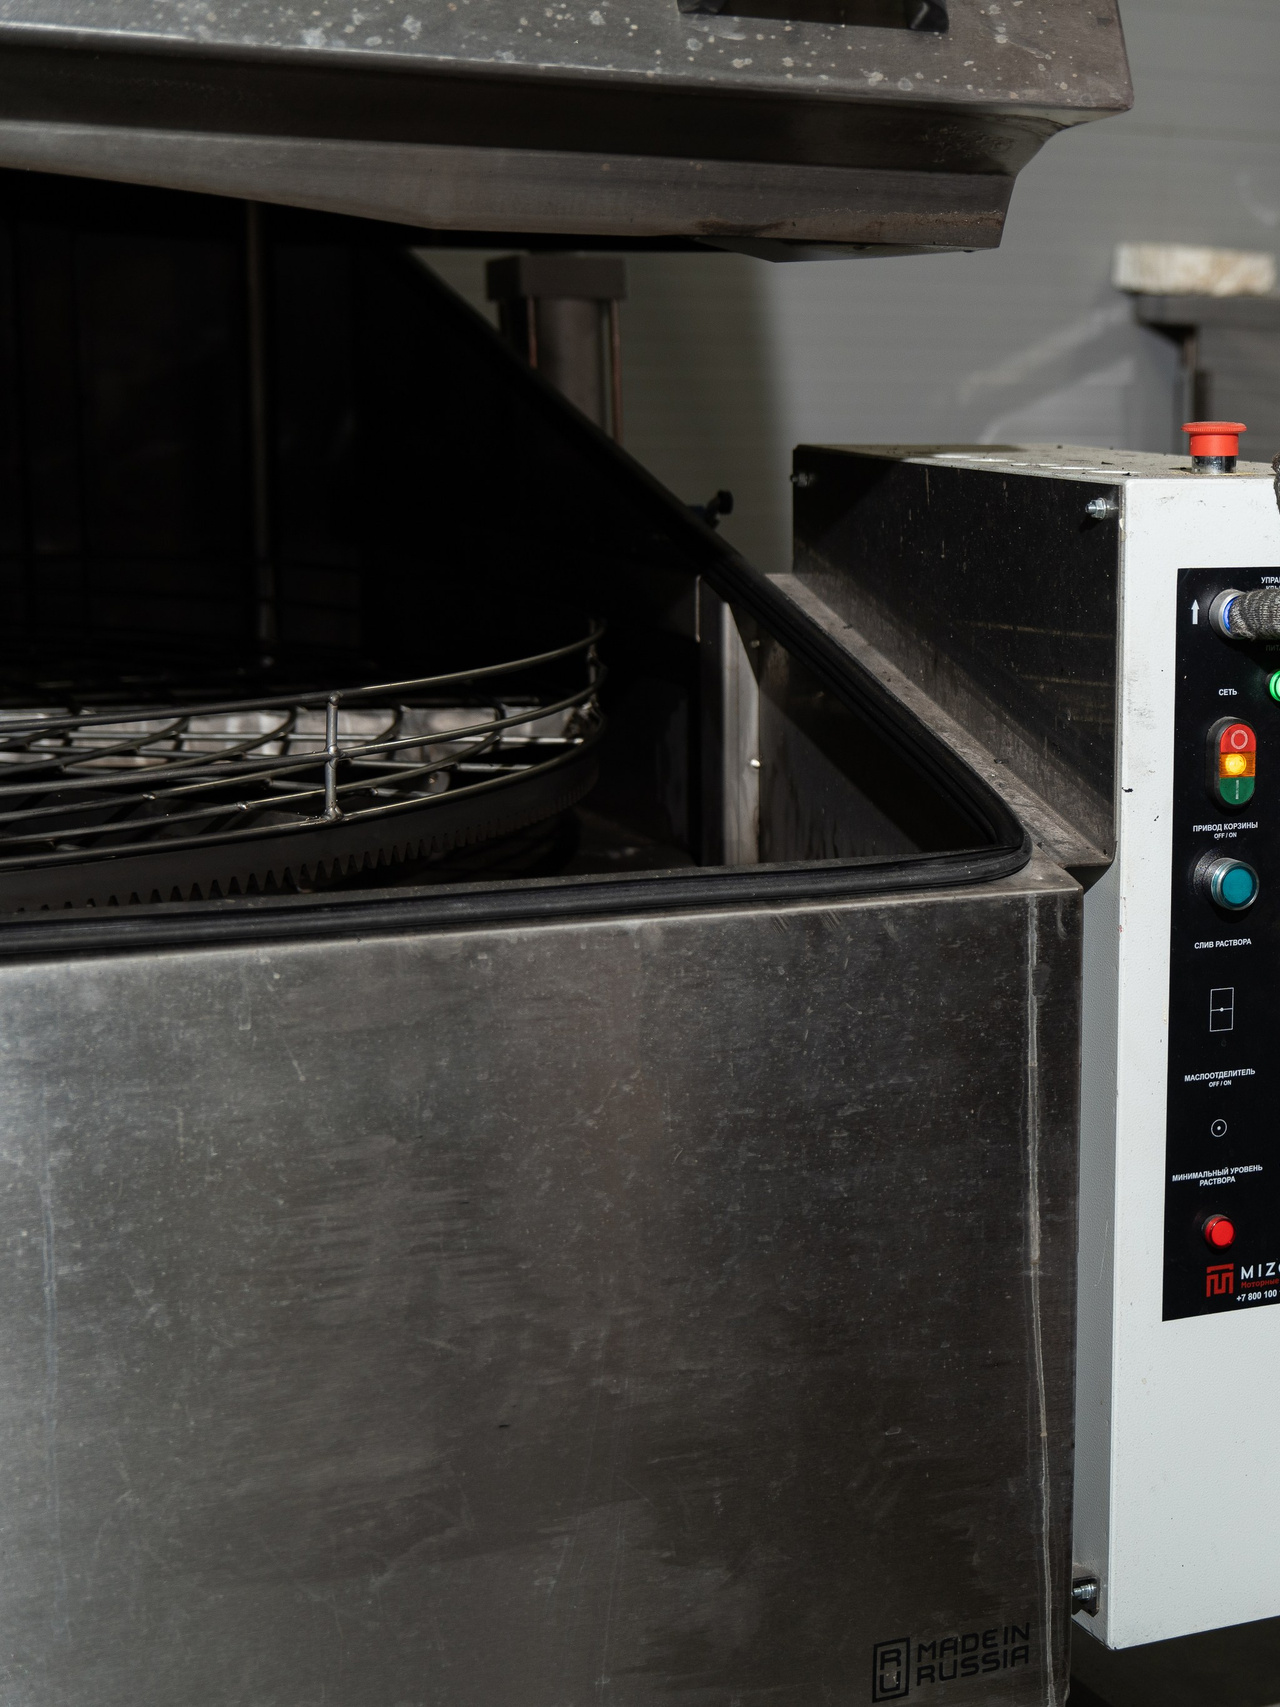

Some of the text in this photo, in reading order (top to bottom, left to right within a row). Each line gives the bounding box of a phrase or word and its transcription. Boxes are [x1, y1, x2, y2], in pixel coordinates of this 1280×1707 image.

[1218, 688, 1238, 696] СЕТЬ
[1192, 821, 1258, 832] ПРИВОД КОРЗИНЫ
[1194, 938, 1252, 949] СЛИВ РАСТВОРА
[1184, 1068, 1256, 1082] МАСЛООТДЕЛИТЕЛЬ
[1172, 1164, 1263, 1182] МИНИМАЛЬНЫЙ УРОВЕНЬ
[1199, 1176, 1236, 1187] РАСТВОРА
[1240, 1277, 1280, 1288] Моторные
[1236, 1293, 1246, 1302] +7
[1247, 1291, 1262, 1301] 800
[1263, 1289, 1278, 1299] 100
[917, 1622, 1030, 1663] MADE IN
[916, 1644, 1029, 1687] RUSSIA
